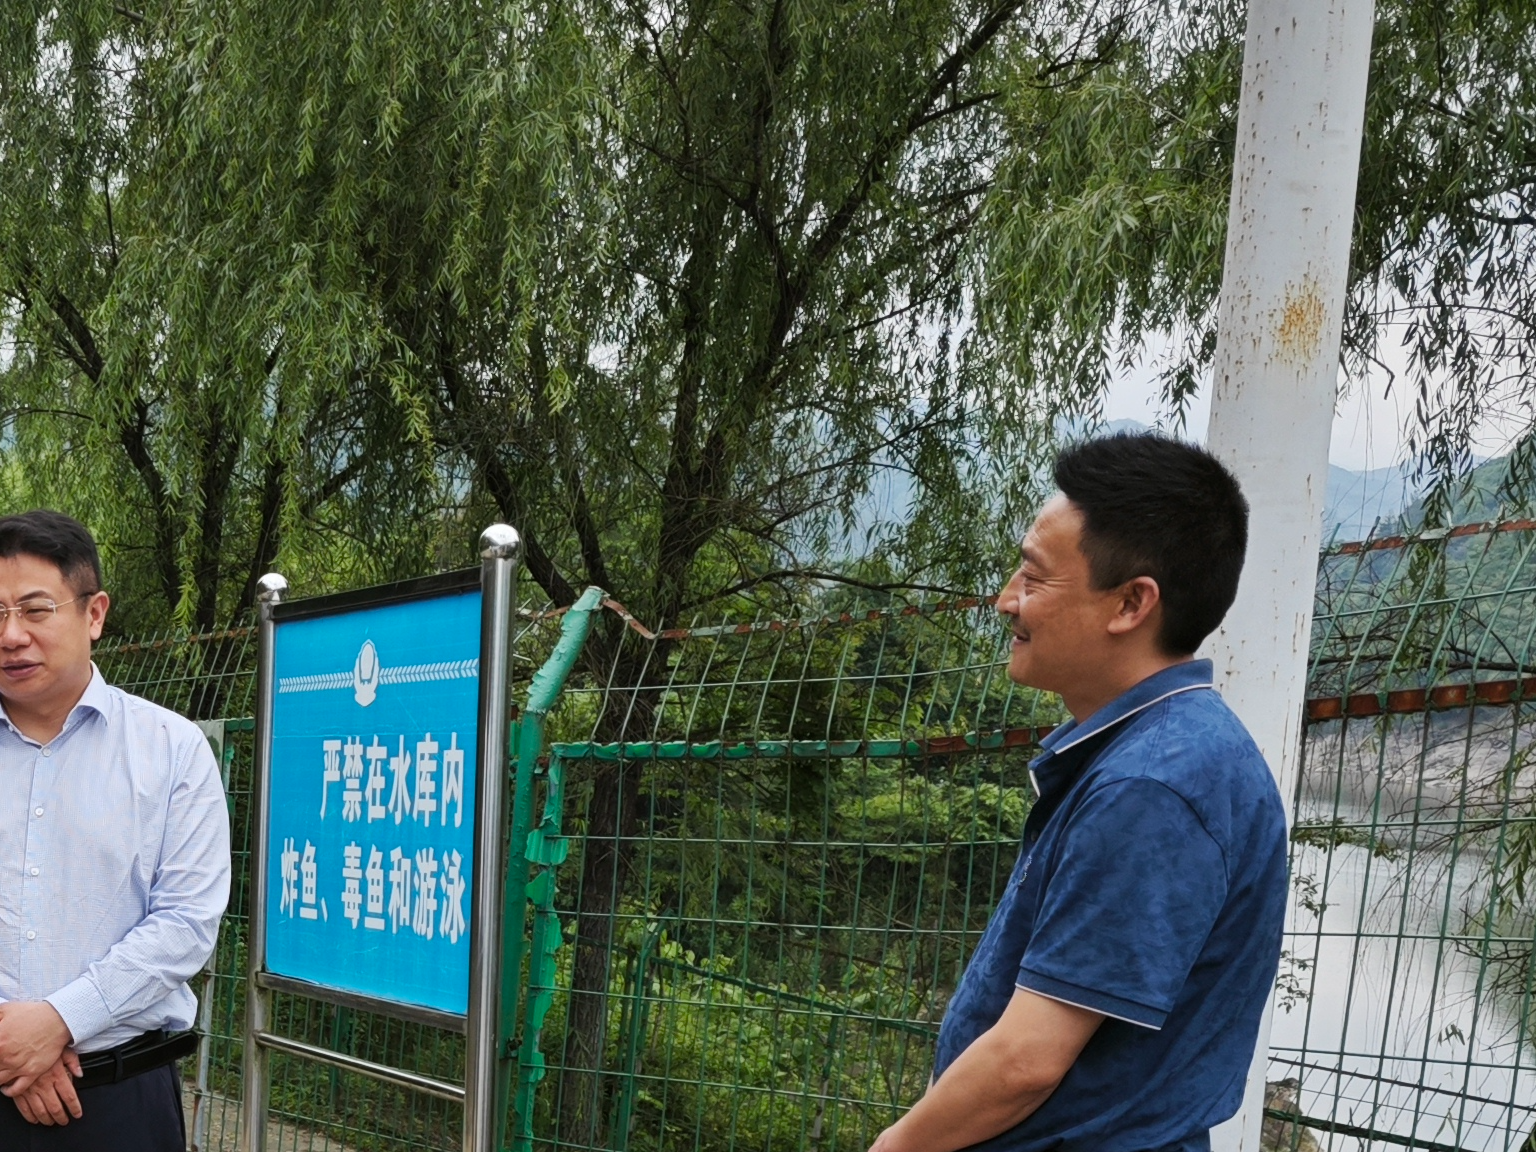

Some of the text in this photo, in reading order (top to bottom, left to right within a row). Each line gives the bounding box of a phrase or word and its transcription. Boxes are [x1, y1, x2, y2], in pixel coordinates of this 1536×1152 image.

[320, 732, 464, 827] 严禁在水库内
[280, 837, 465, 943] 炸鱼、毒鱼和游泳
